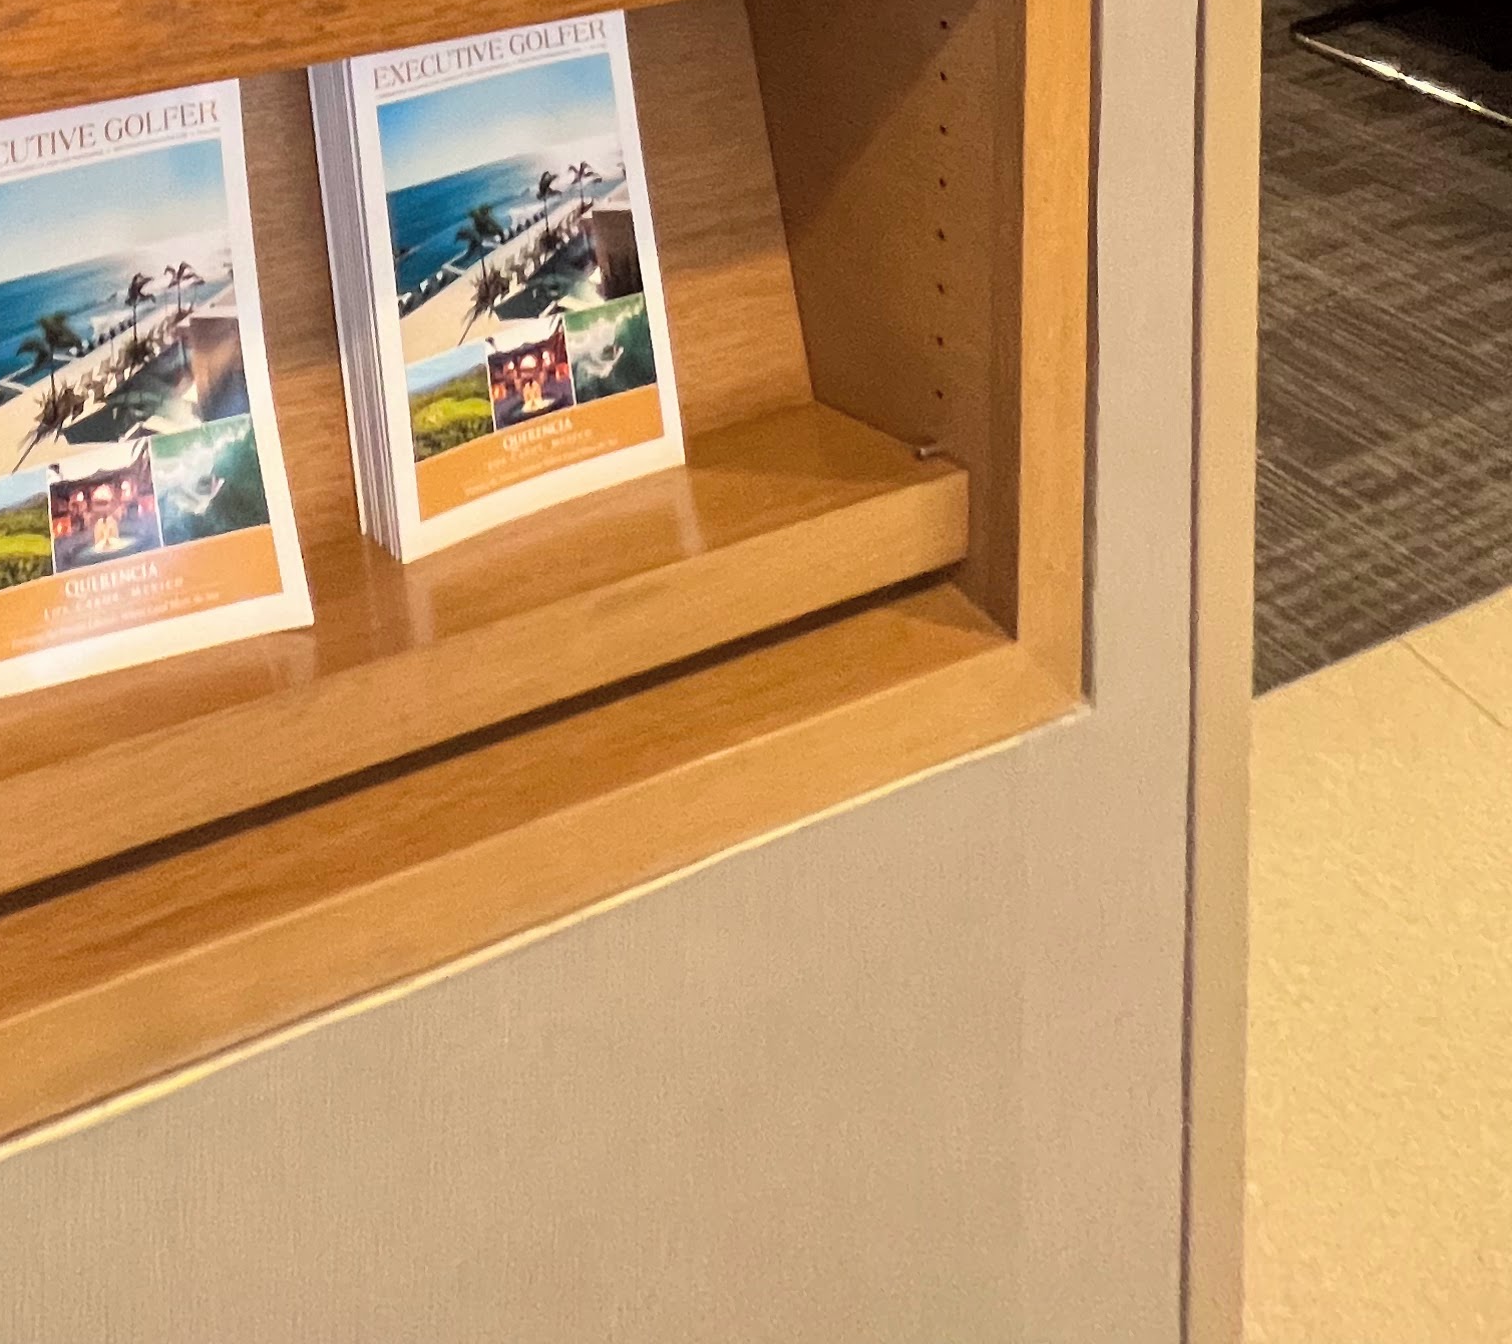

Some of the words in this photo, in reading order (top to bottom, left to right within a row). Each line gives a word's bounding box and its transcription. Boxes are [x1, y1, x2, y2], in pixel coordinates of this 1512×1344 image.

[373, 40, 504, 91] EXECUTIVE
[509, 19, 607, 56] GOLFER
[104, 100, 219, 144] GOLFER
